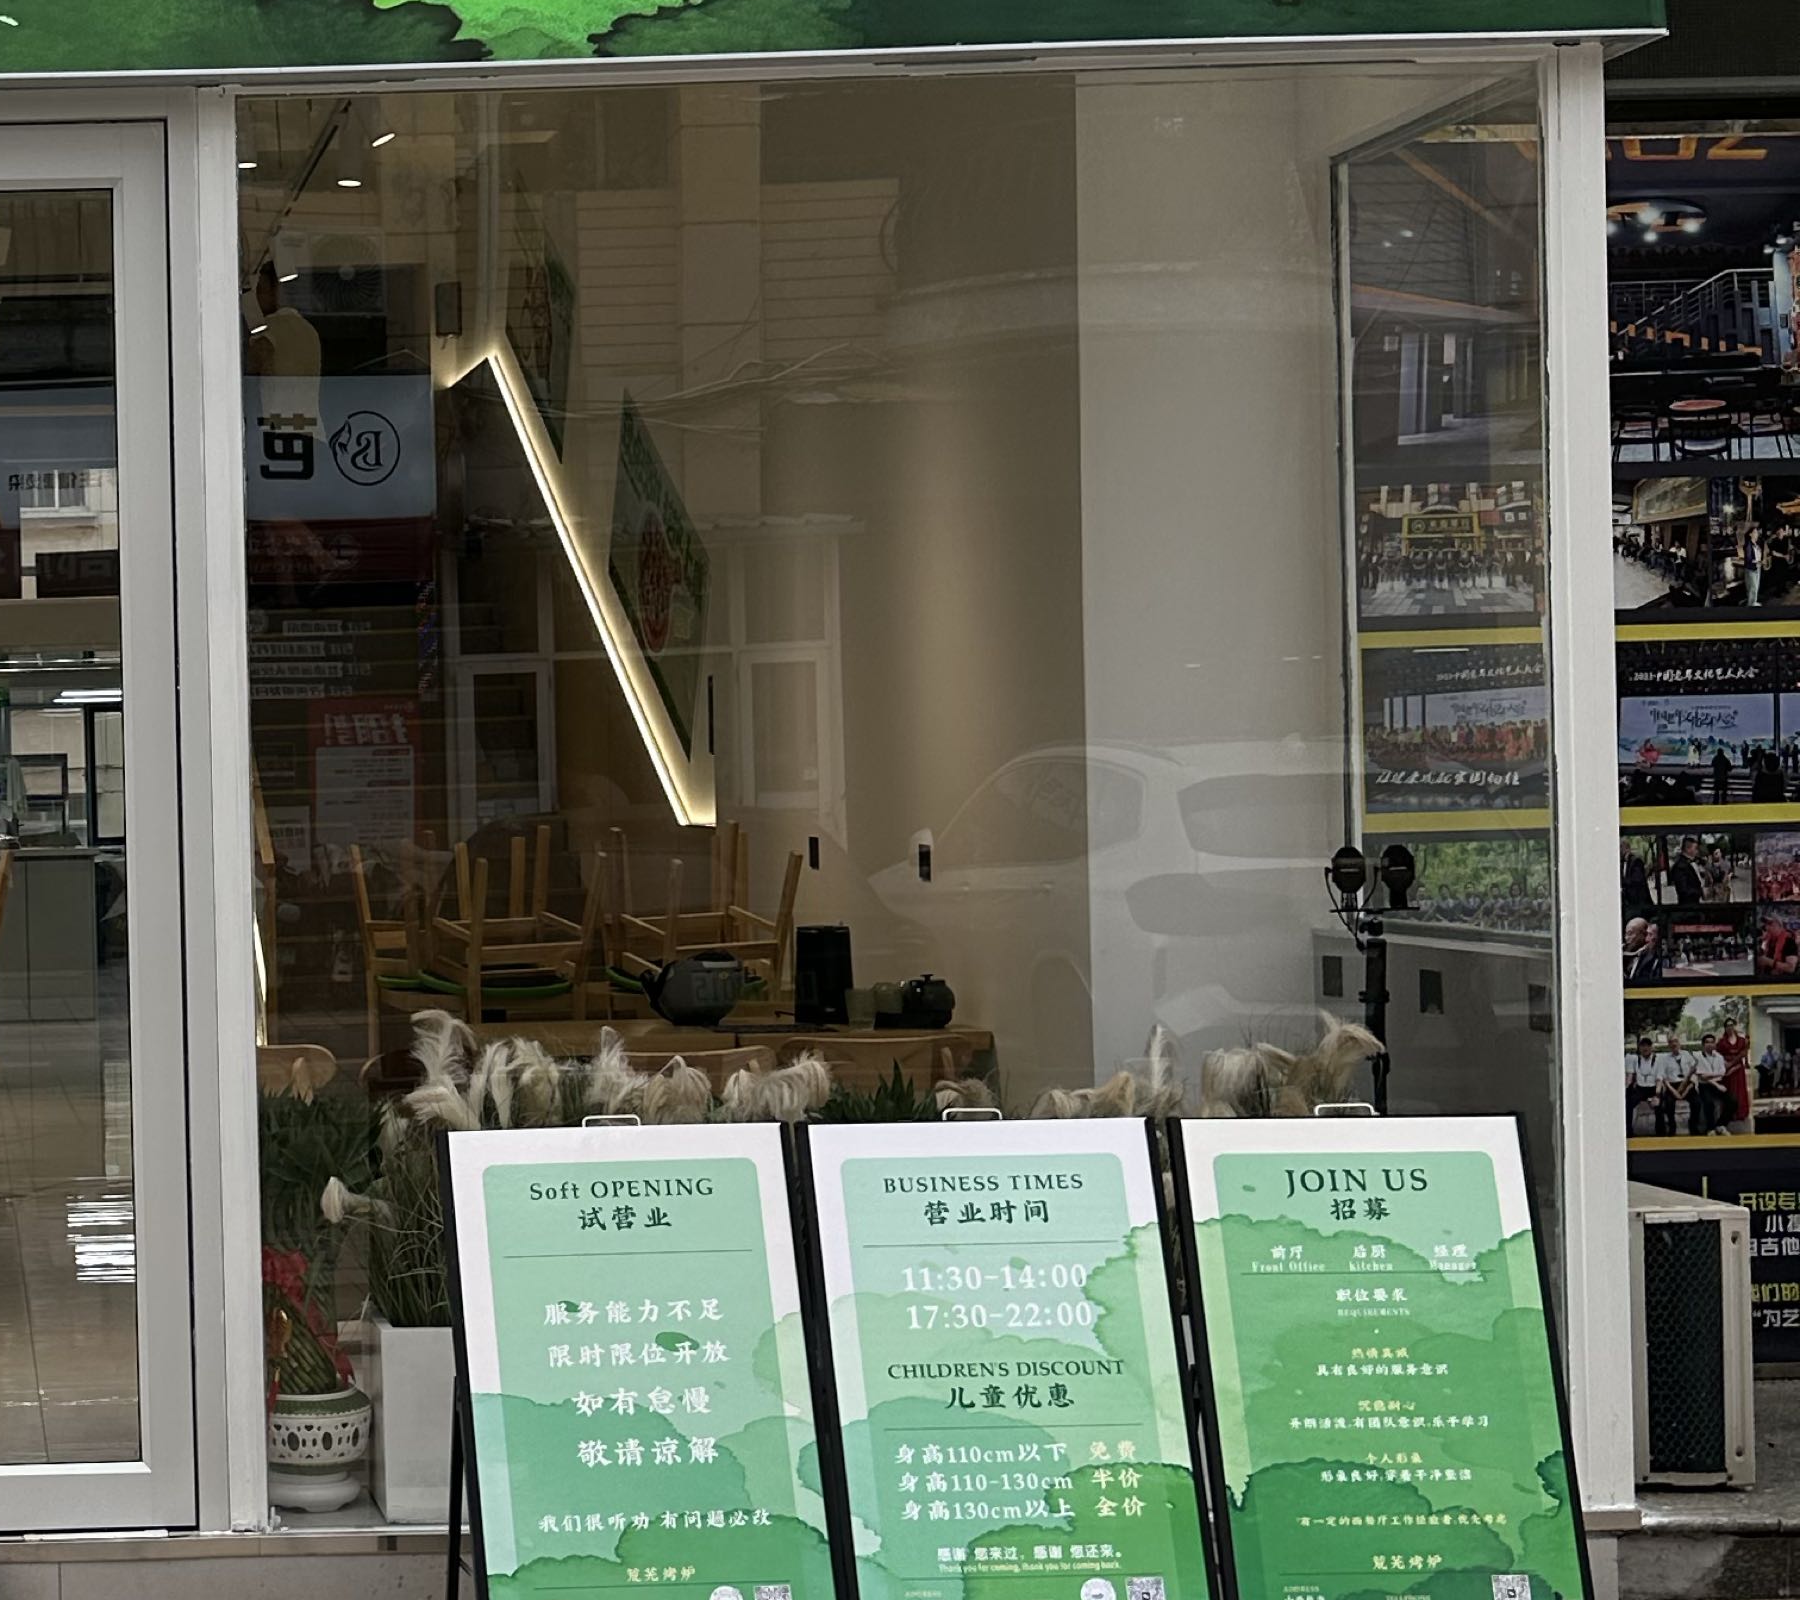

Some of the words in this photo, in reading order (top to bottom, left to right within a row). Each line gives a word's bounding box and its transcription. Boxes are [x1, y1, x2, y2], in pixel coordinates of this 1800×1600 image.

[530, 1181, 580, 1200] Soft
[591, 1178, 714, 1199] OPENING
[884, 1175, 1000, 1194] BUSINESS
[1010, 1173, 1083, 1190] TIMES
[1285, 1168, 1368, 1198] JOIN
[1382, 1168, 1429, 1191] US
[924, 1200, 1050, 1226] 营业时间
[1330, 1197, 1390, 1221] 招募
[1738, 1192, 1800, 1211] 开设专
[578, 1207, 673, 1231] 试营业
[902, 1263, 1088, 1292] 11:30-14:00
[544, 1299, 724, 1325] 服务能力不足
[907, 1301, 1093, 1330] 17:30-22:00
[548, 1341, 730, 1368] 限时限位开放
[887, 1360, 1010, 1380] CHILDREN'S
[1017, 1359, 1125, 1377] DISCOUNT
[572, 1387, 712, 1416] 如有怠慢
[945, 1382, 1075, 1410] 儿童优惠
[577, 1436, 719, 1467] 敬请谅解
[895, 1442, 1067, 1465] 身高110cm以下
[1089, 1440, 1137, 1461] 免费
[898, 1471, 1074, 1493] 身高110-130cm
[1091, 1468, 1144, 1489] 半价
[901, 1498, 1076, 1521] 身高130cm以上
[1095, 1495, 1147, 1517] 全价
